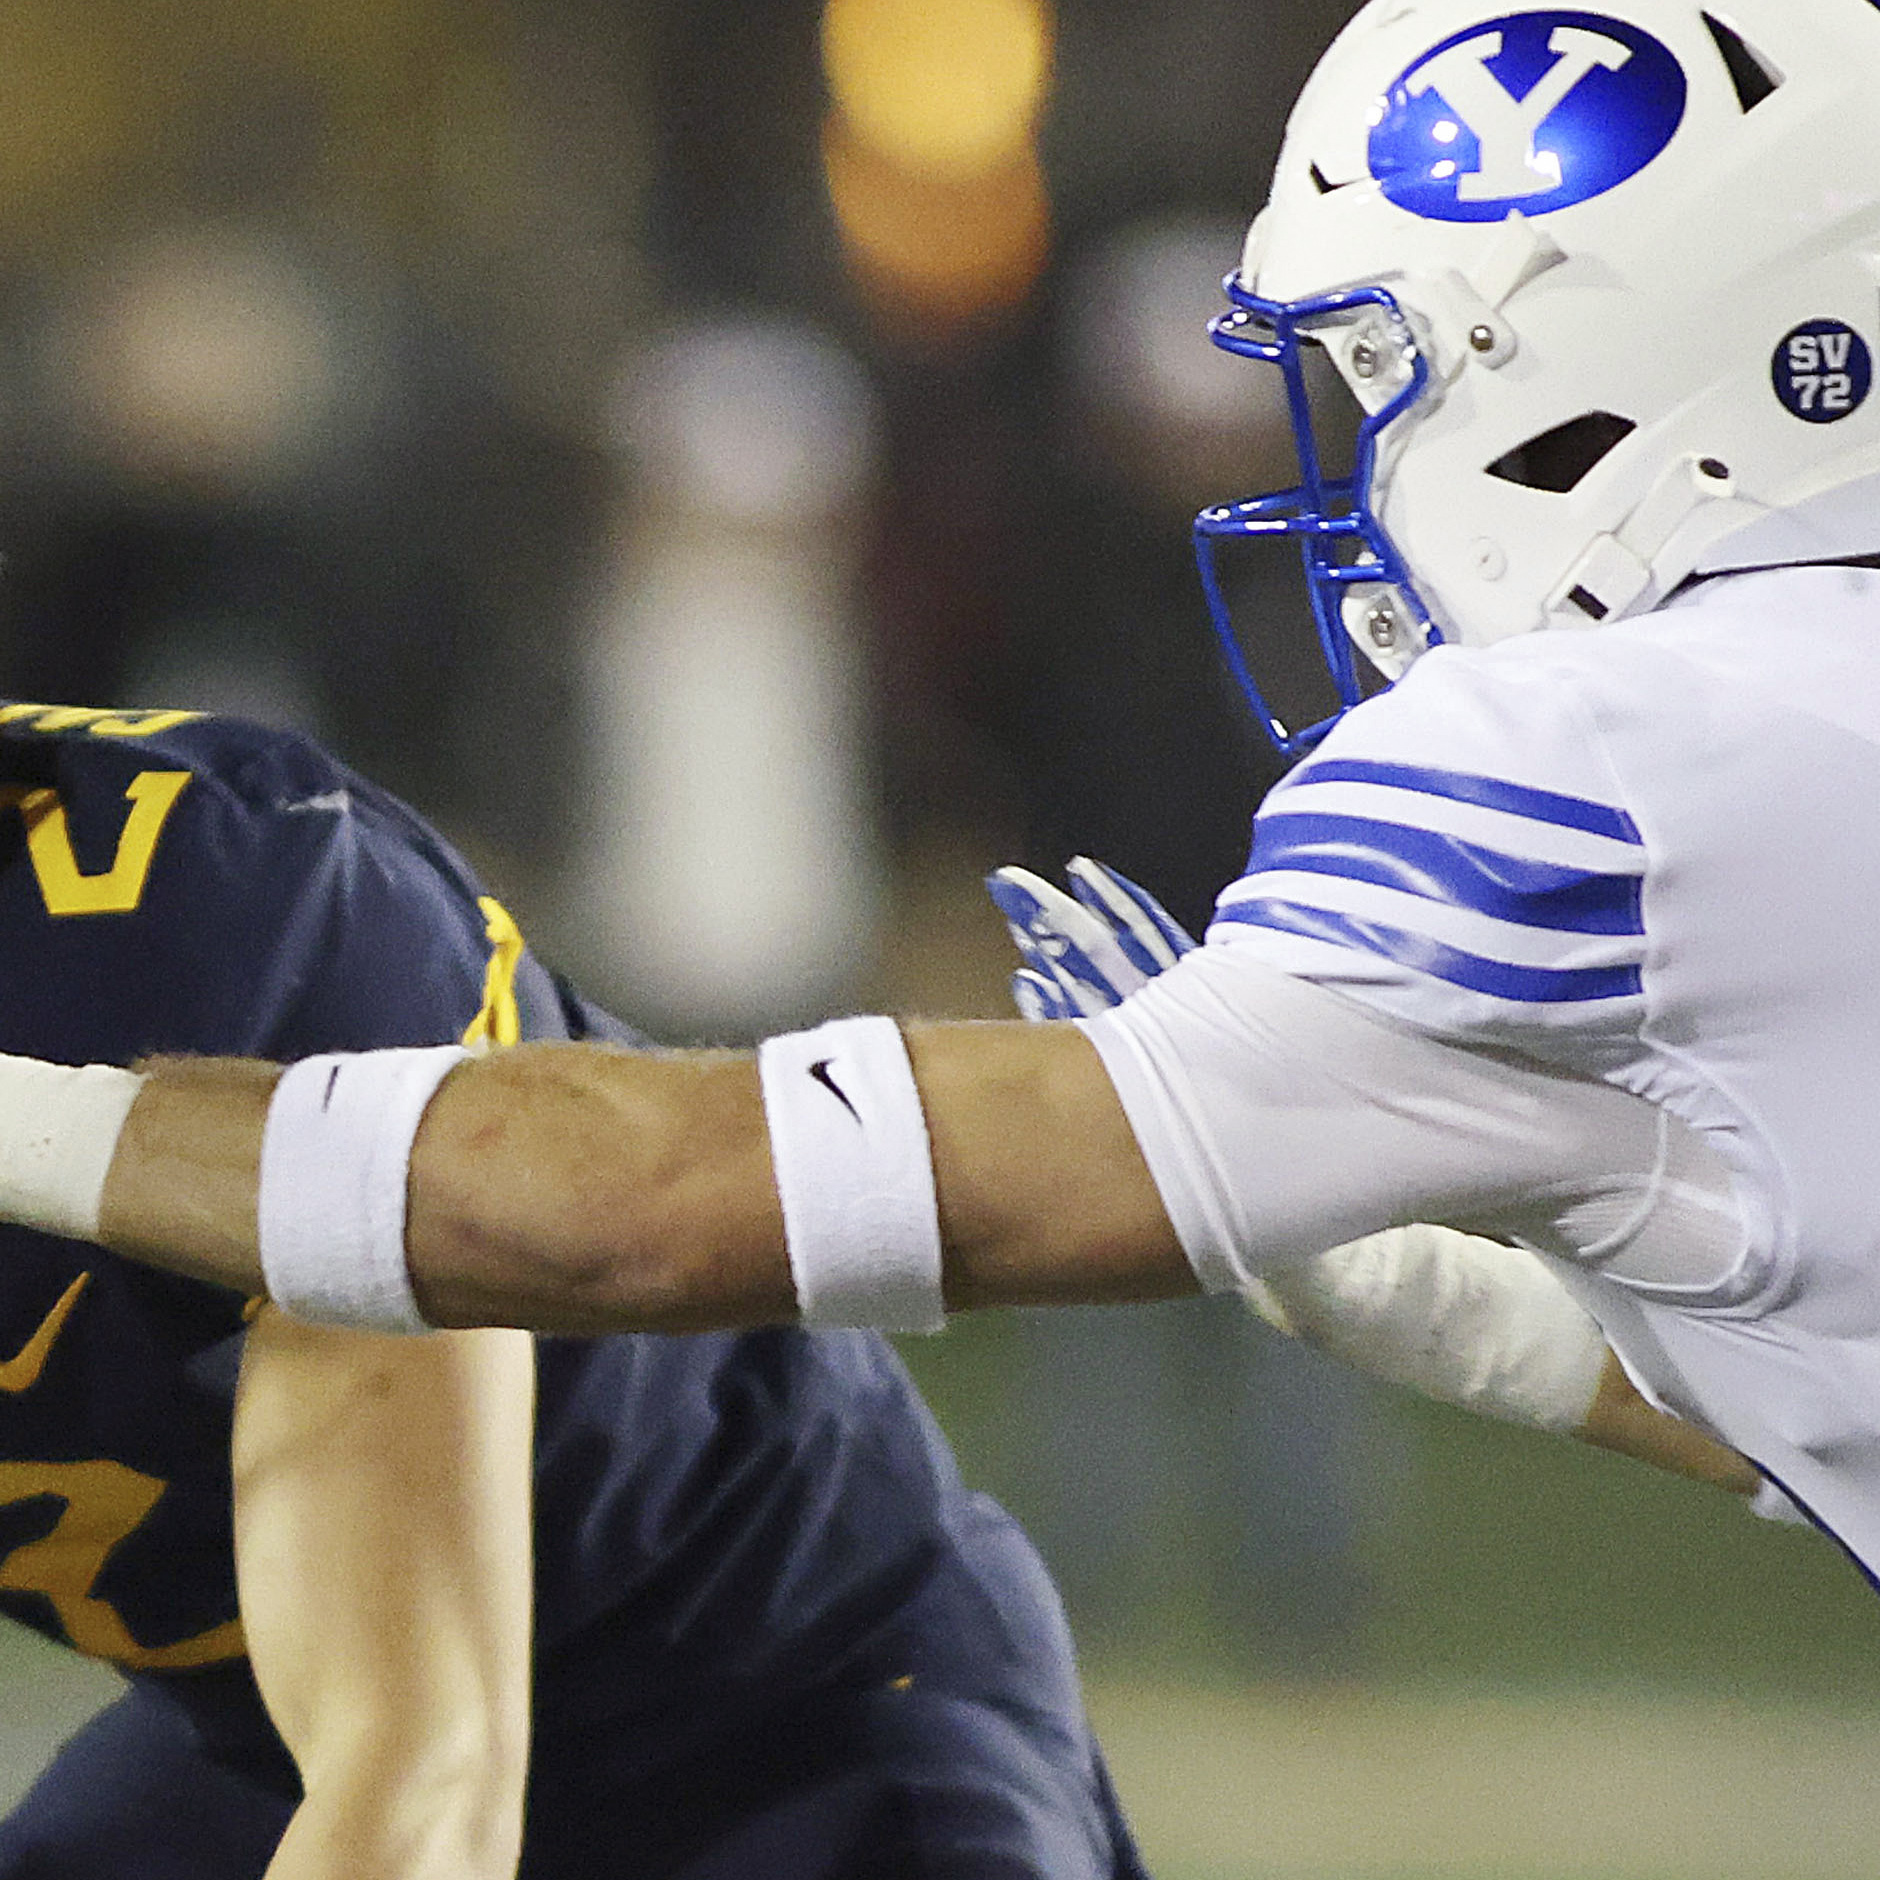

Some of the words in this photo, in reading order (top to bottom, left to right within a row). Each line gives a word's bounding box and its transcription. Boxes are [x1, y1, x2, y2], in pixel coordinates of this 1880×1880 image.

[1405, 27, 1632, 201] Y
[1788, 334, 1853, 371] SV
[1794, 375, 1851, 410] 72
